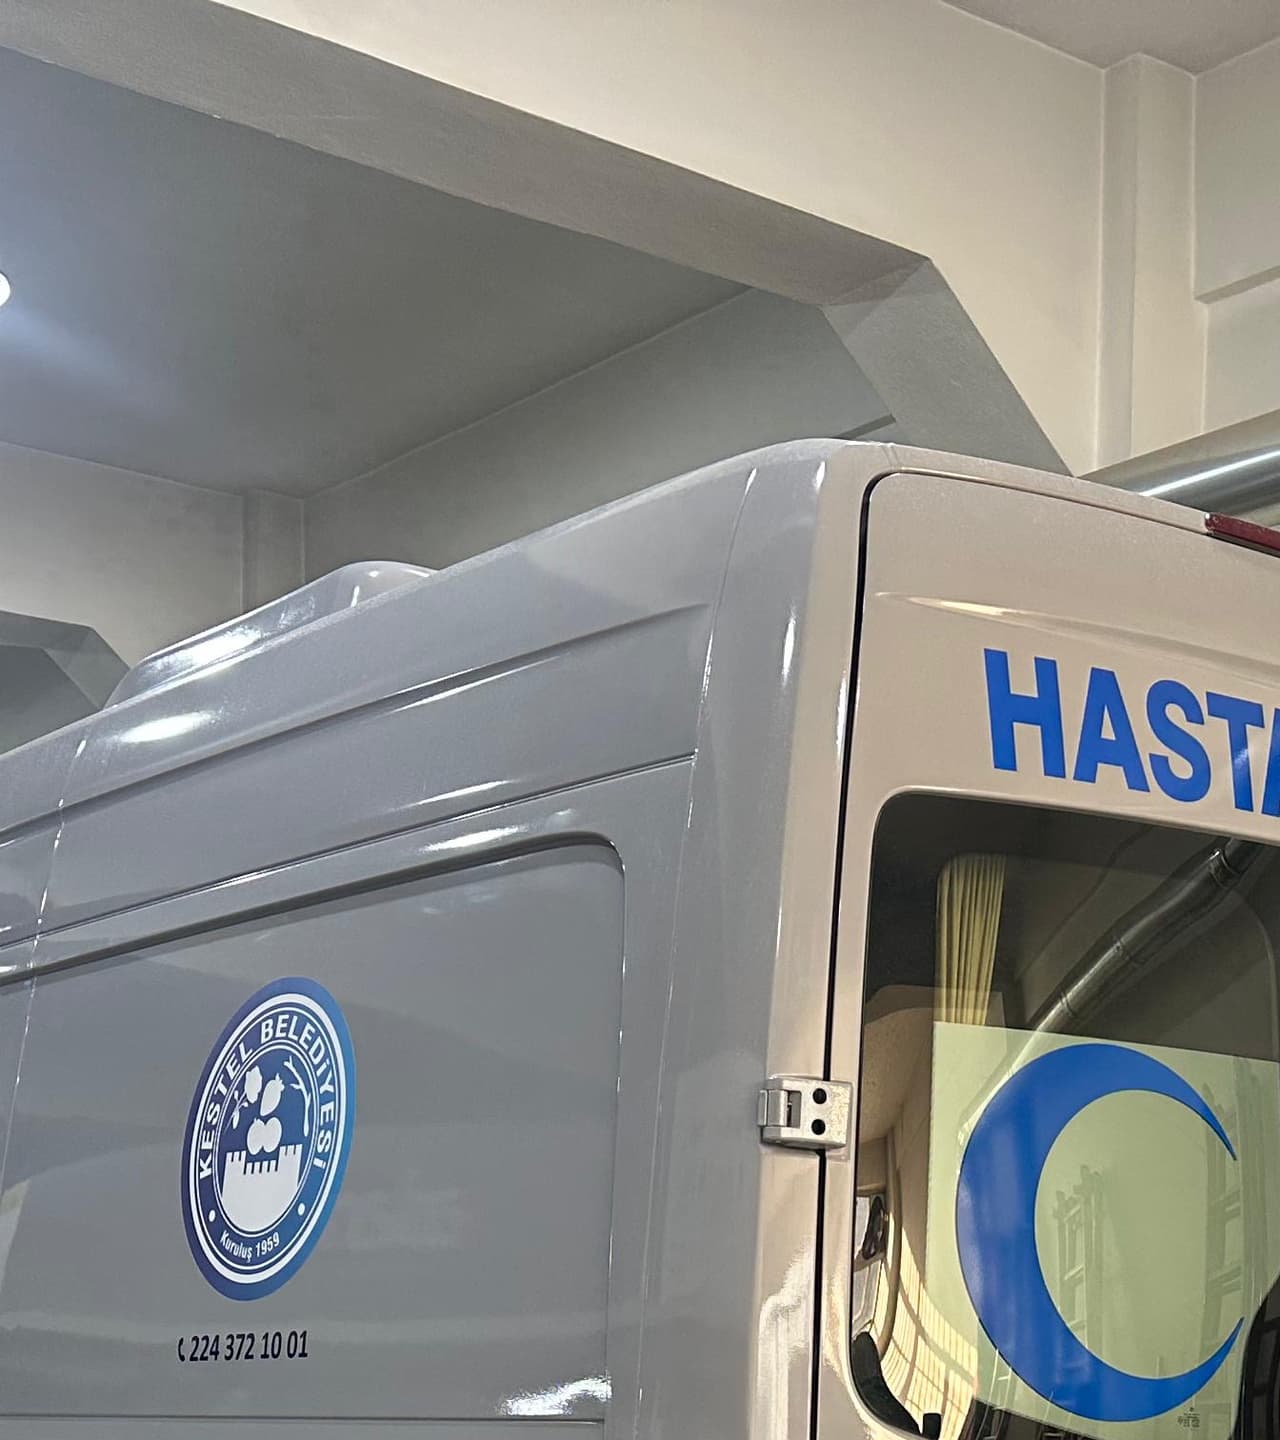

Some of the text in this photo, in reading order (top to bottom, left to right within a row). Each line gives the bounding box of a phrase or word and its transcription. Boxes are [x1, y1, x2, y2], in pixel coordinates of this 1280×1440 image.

[198, 1042, 255, 1180] KESTEL
[219, 1231, 281, 1264] Kuruluş 1959
[189, 1330, 308, 1362] 224 372 10 01
